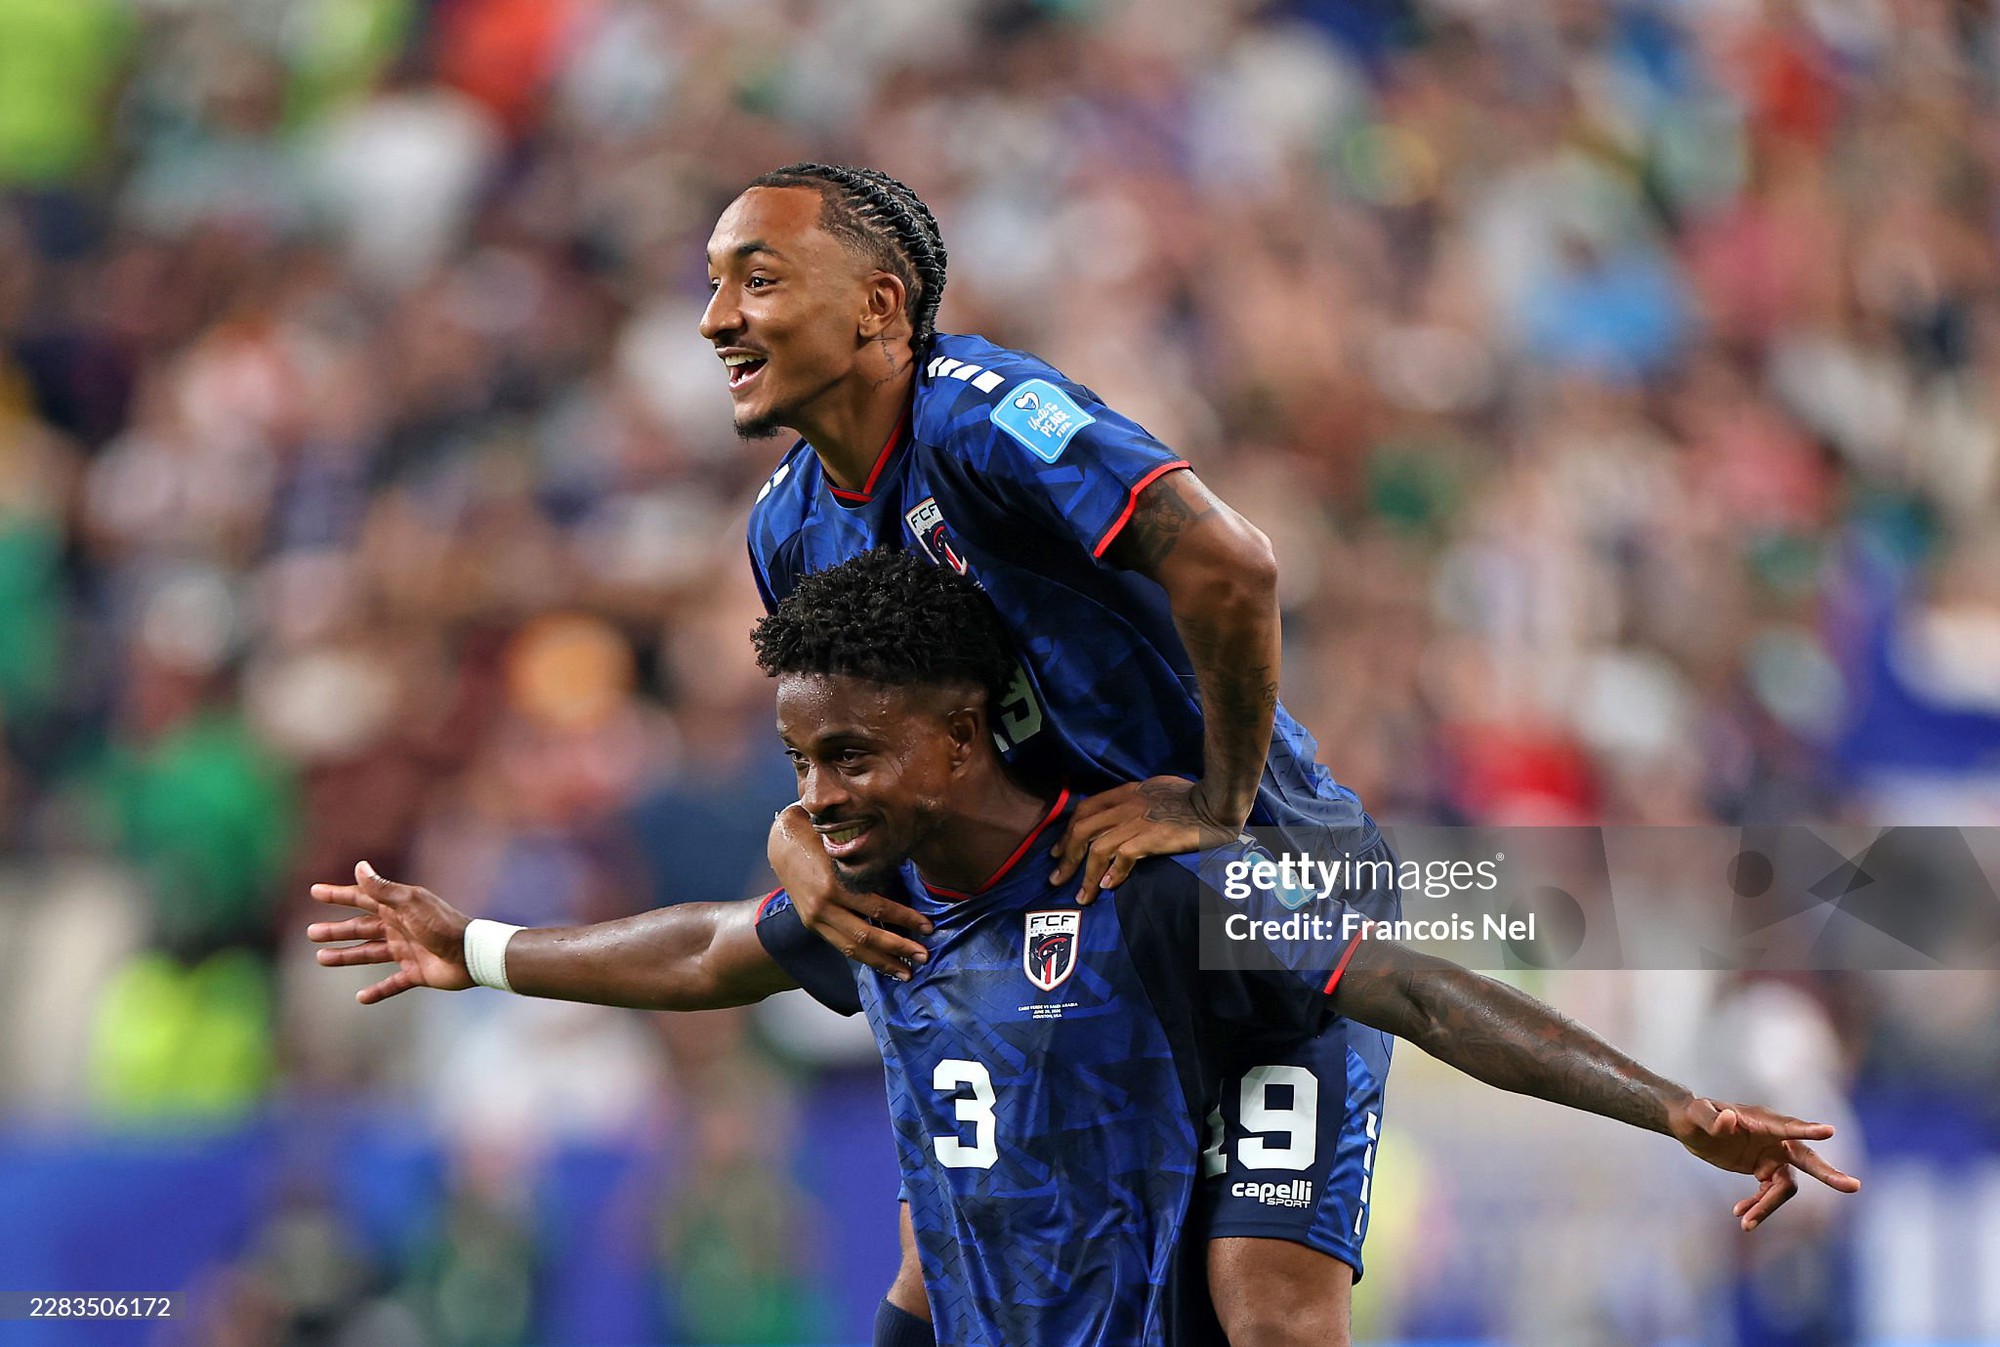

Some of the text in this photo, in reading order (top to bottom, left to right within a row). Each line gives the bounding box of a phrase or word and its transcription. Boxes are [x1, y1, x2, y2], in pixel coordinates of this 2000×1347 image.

[1040, 411, 1071, 438] PEACE
[910, 503, 936, 529] FCF
[1030, 915, 1076, 929] FCF
[932, 1059, 999, 1170] 3
[1231, 1179, 1313, 1203] capelli
[1266, 1197, 1311, 1209] SPORT
